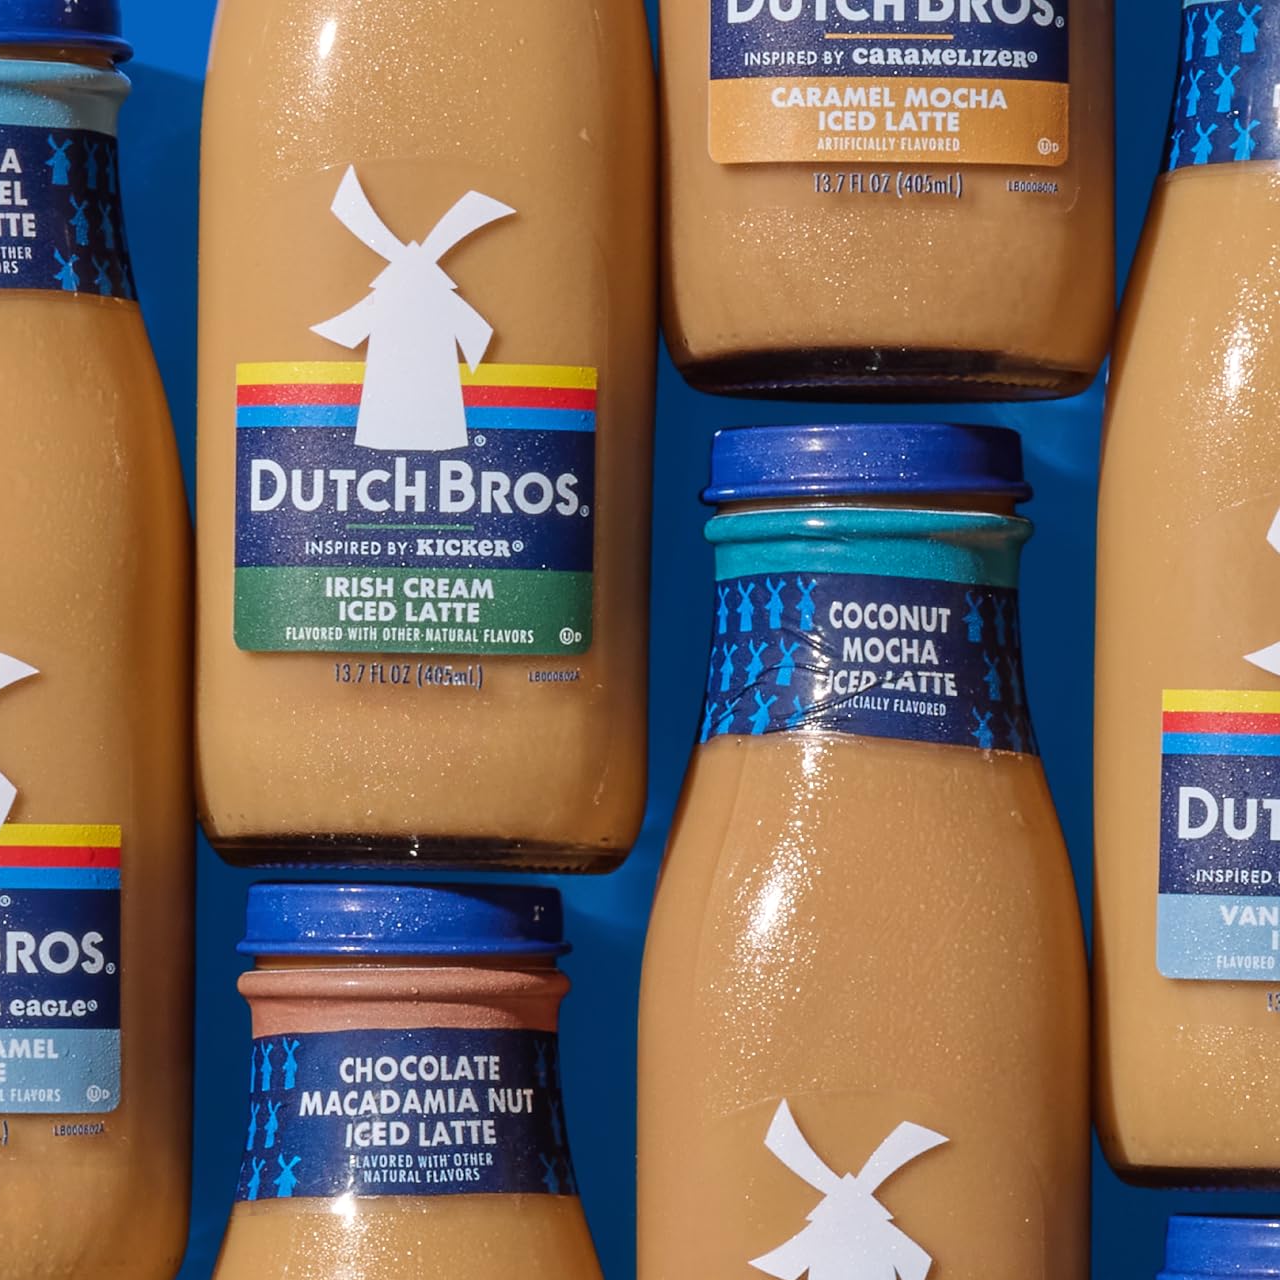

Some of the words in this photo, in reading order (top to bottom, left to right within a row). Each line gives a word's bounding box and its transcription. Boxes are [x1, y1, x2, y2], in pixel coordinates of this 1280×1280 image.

[744, 52, 817, 65] INSPIRED
[824, 51, 843, 64] BY
[771, 87, 895, 107] CARAMEL
[904, 88, 1007, 109] MOCHA
[819, 111, 875, 131] ICED
[885, 112, 960, 132] LATTE
[817, 138, 896, 151] ARTIFICIALLY
[900, 138, 960, 151] FLAVORED
[306, 542, 381, 555] INSPIRED
[388, 542, 407, 555] BY
[326, 577, 394, 598] IRISH
[403, 579, 494, 599] CREAM
[339, 601, 397, 621] ICED
[406, 602, 480, 622] LATTE
[829, 602, 951, 633] COCONUT
[843, 637, 939, 665] MOCHA
[1196, 870, 1271, 884] INSPIRED
[340, 1056, 500, 1083] CHOCOLATE
[299, 1088, 479, 1116] MACADAMIA
[488, 1088, 534, 1113] NUT
[345, 1122, 410, 1147] ICED
[419, 1120, 496, 1147] LATTE
